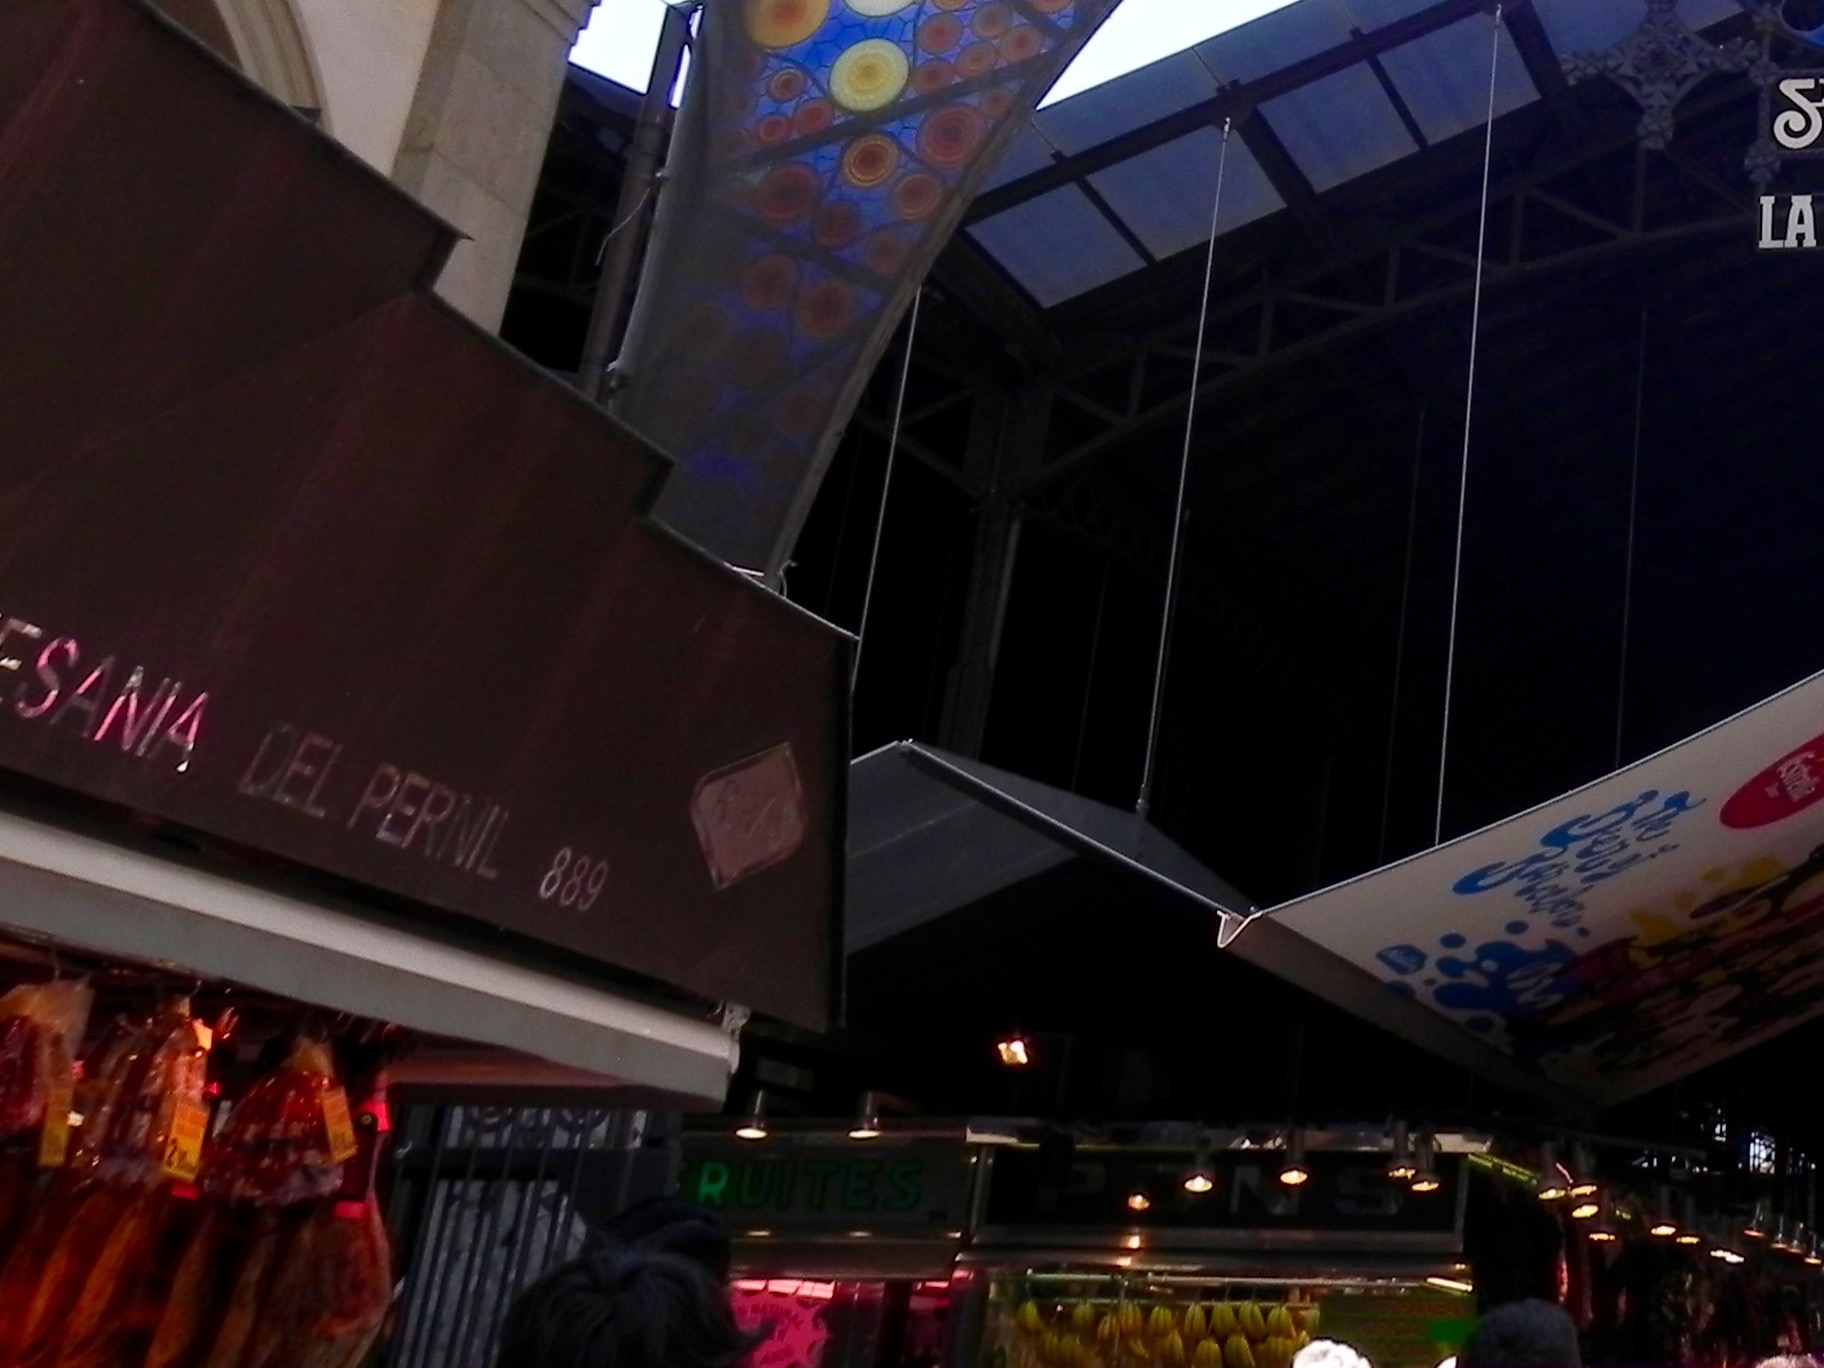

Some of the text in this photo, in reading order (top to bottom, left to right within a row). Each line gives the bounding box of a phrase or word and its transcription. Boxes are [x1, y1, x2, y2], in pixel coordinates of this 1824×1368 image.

[1758, 195, 1817, 249] LA
[238, 719, 343, 819] DEL
[346, 761, 511, 880] PERNIL
[538, 846, 609, 911] 889
[684, 1159, 925, 1211] RUITES
